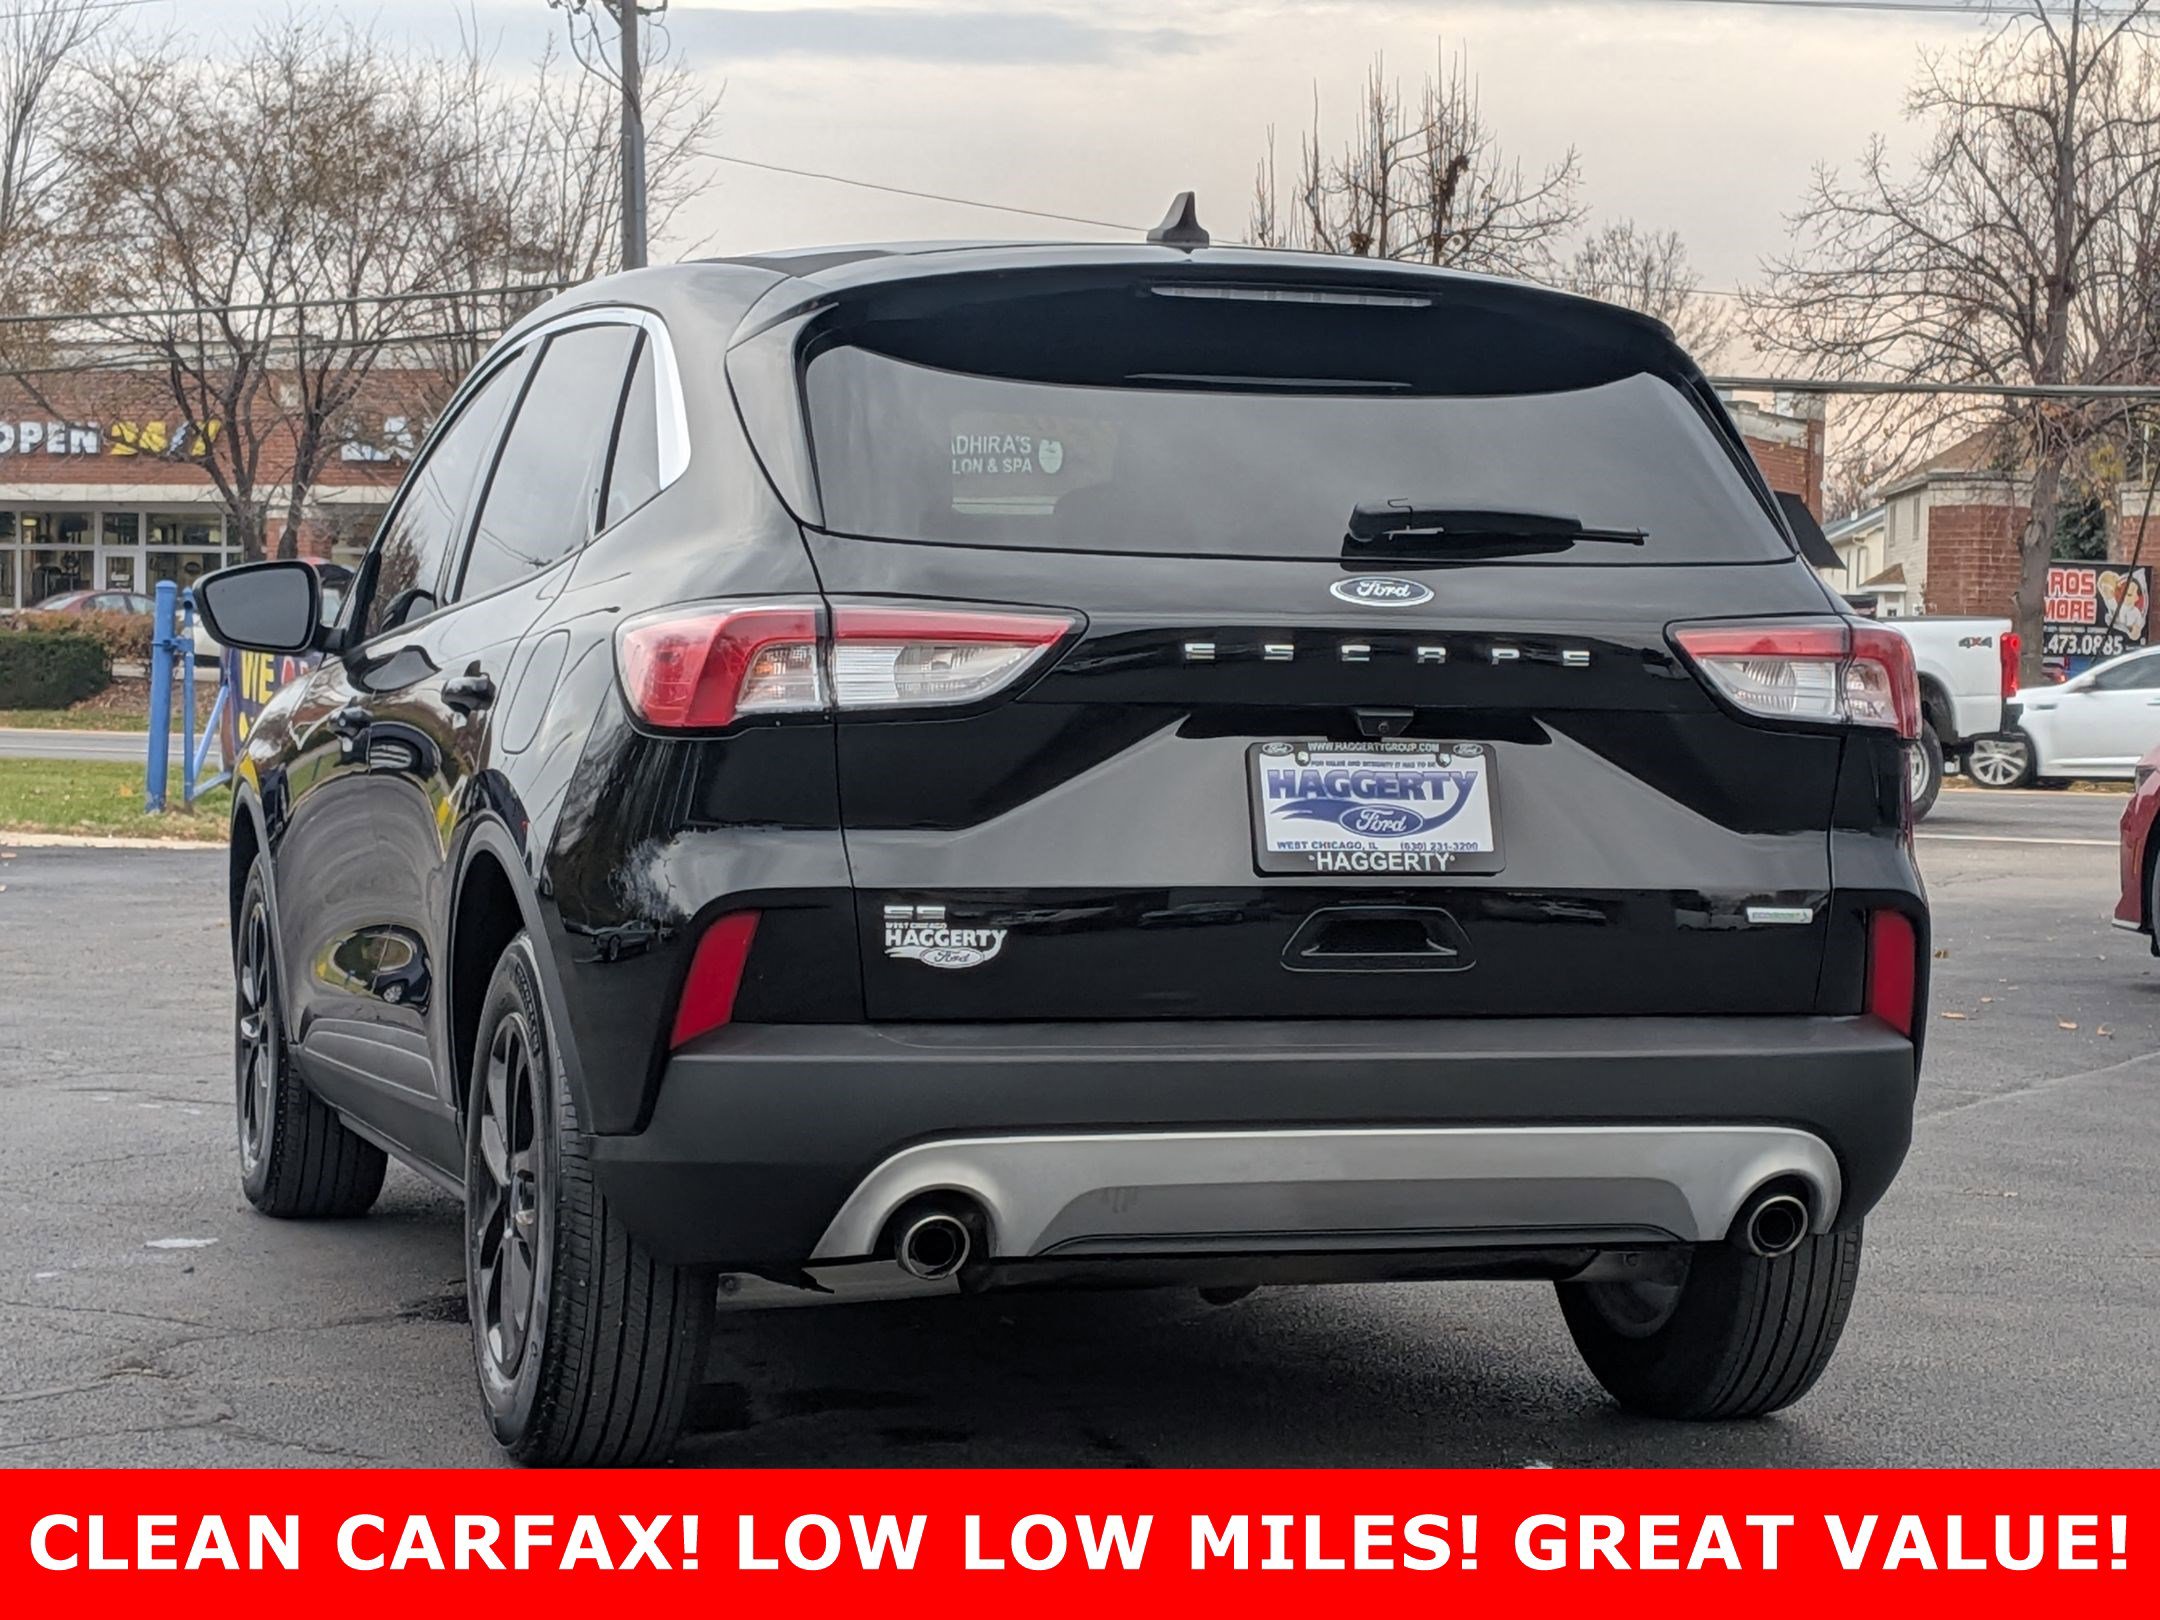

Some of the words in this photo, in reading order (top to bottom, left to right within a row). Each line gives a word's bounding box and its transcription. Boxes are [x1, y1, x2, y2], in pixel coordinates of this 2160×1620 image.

[0, 421, 98, 453] OPEN
[987, 458, 999, 473] &
[1002, 458, 1033, 474] SPA
[1356, 581, 1411, 598] Ford
[1184, 642, 1590, 668] ESCAPE
[241, 650, 275, 704] WE
[1267, 769, 1479, 801] HAGGERTY
[1355, 808, 1407, 832] Ford
[1277, 841, 1308, 850] WEST
[1311, 841, 1366, 851] CHICAGO,
[1368, 842, 1379, 850] IL
[1430, 841, 1479, 851] 231-3200
[1316, 851, 1450, 872] HAGGERTY
[884, 905, 946, 920] SE
[885, 929, 1008, 948] HAGGERTY
[934, 950, 970, 963] Ford
